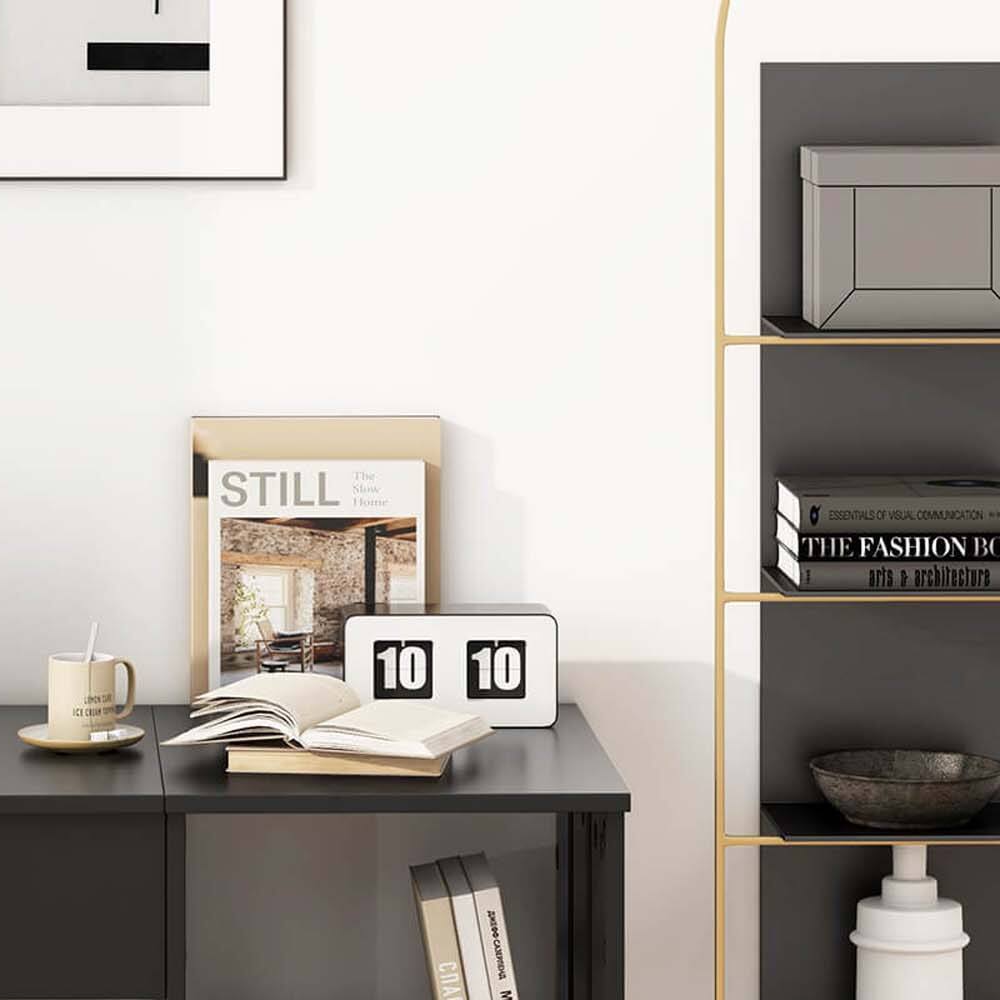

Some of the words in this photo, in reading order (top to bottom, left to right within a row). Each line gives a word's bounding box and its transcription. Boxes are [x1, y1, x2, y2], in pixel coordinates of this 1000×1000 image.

[220, 471, 340, 508] STILL
[828, 509, 875, 521] ESSENTIALS
[876, 509, 887, 521] OF
[888, 509, 915, 521] VISUAL
[916, 509, 984, 521] COMMUNICATION
[802, 536, 853, 557] THE
[859, 536, 966, 557] FASHION
[869, 566, 893, 587] arts
[914, 564, 991, 587] architecture
[376, 646, 427, 690] 10
[471, 646, 522, 690] 10
